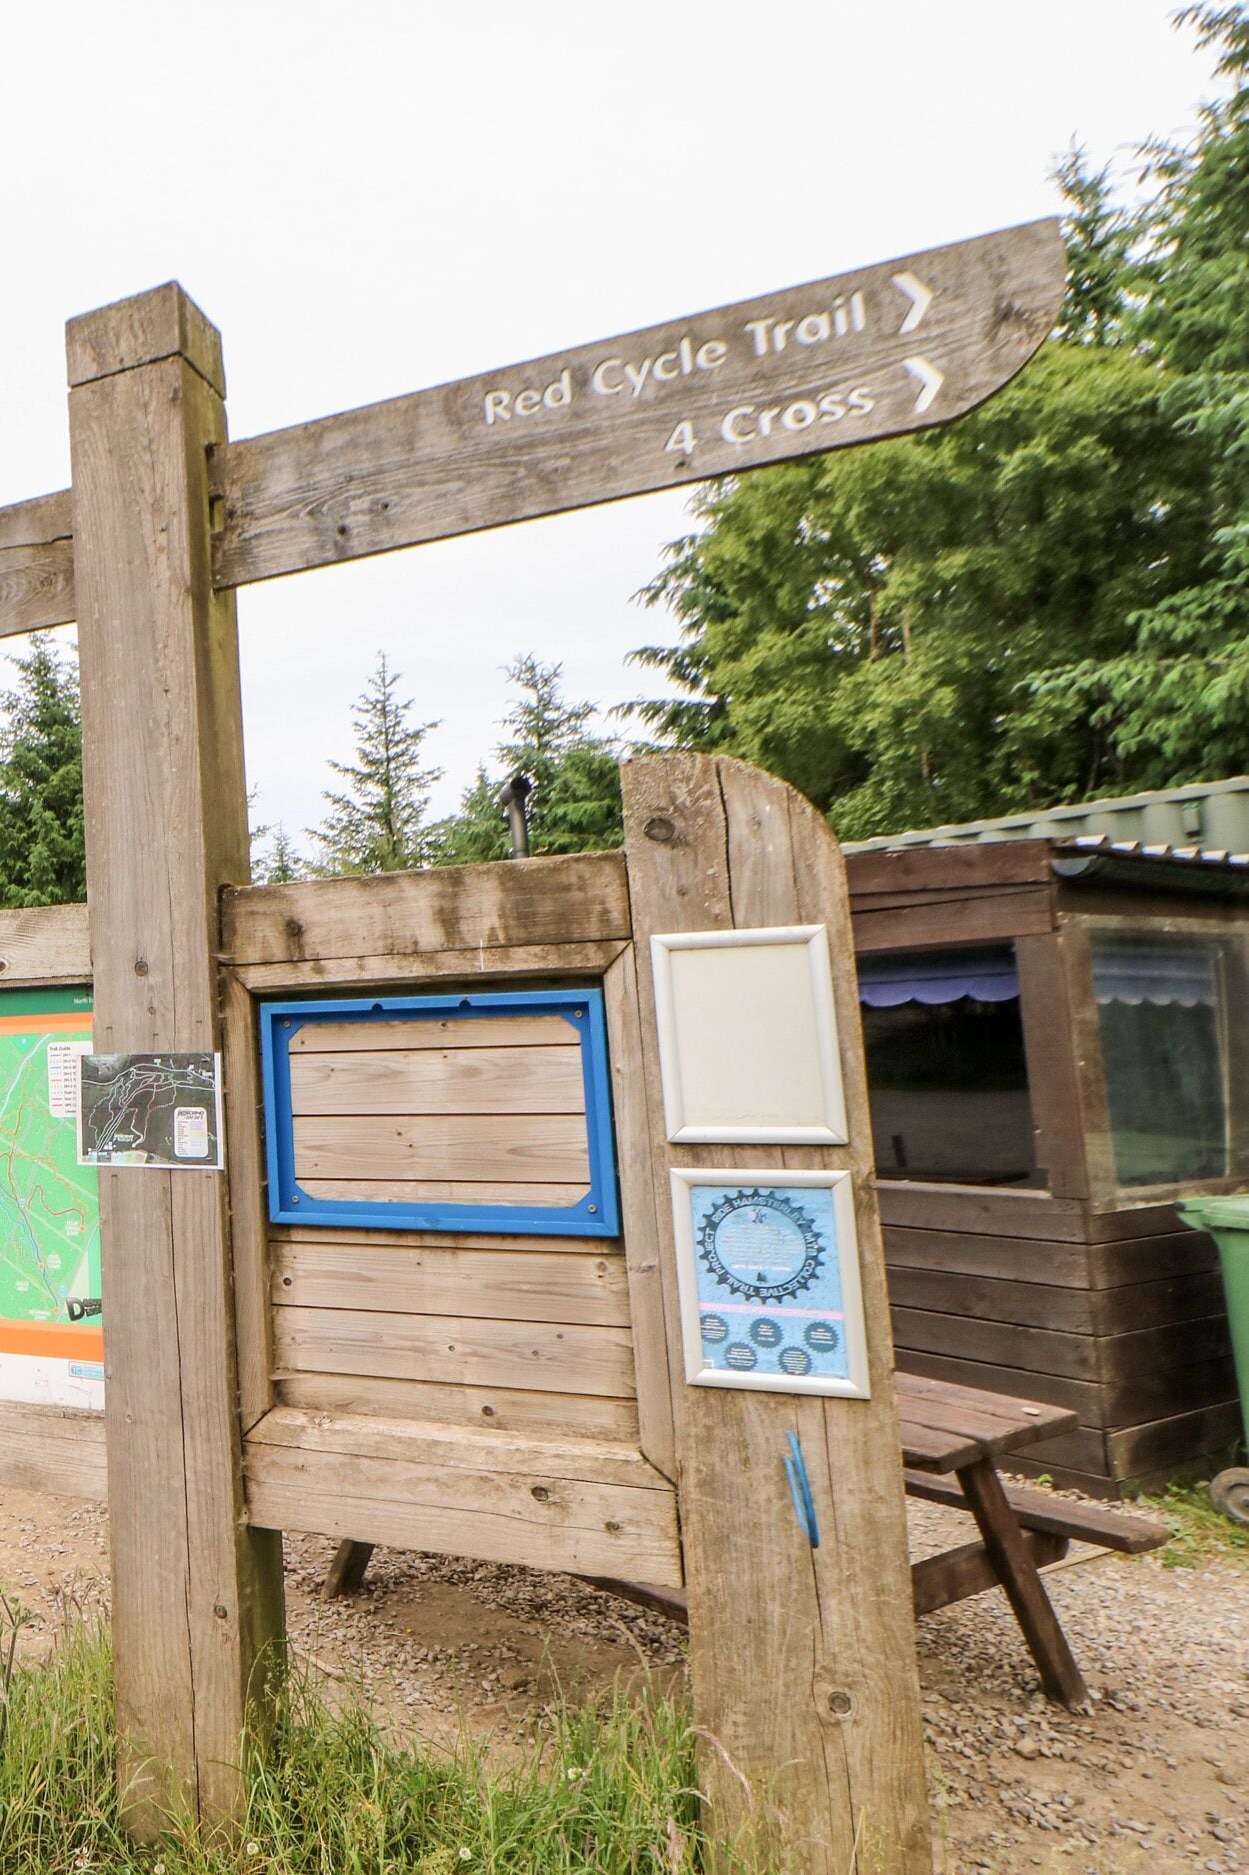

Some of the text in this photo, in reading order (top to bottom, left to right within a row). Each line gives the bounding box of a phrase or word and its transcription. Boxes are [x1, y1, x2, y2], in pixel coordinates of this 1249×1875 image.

[483, 291, 867, 425] Red Cycle Trail
[665, 384, 875, 456] 4 Cross
[711, 1203, 733, 1223] RIDE
[705, 1228, 726, 1275] PROJECT
[726, 1274, 756, 1295] TRAIL
[759, 1260, 816, 1297] COLLECTIVE
